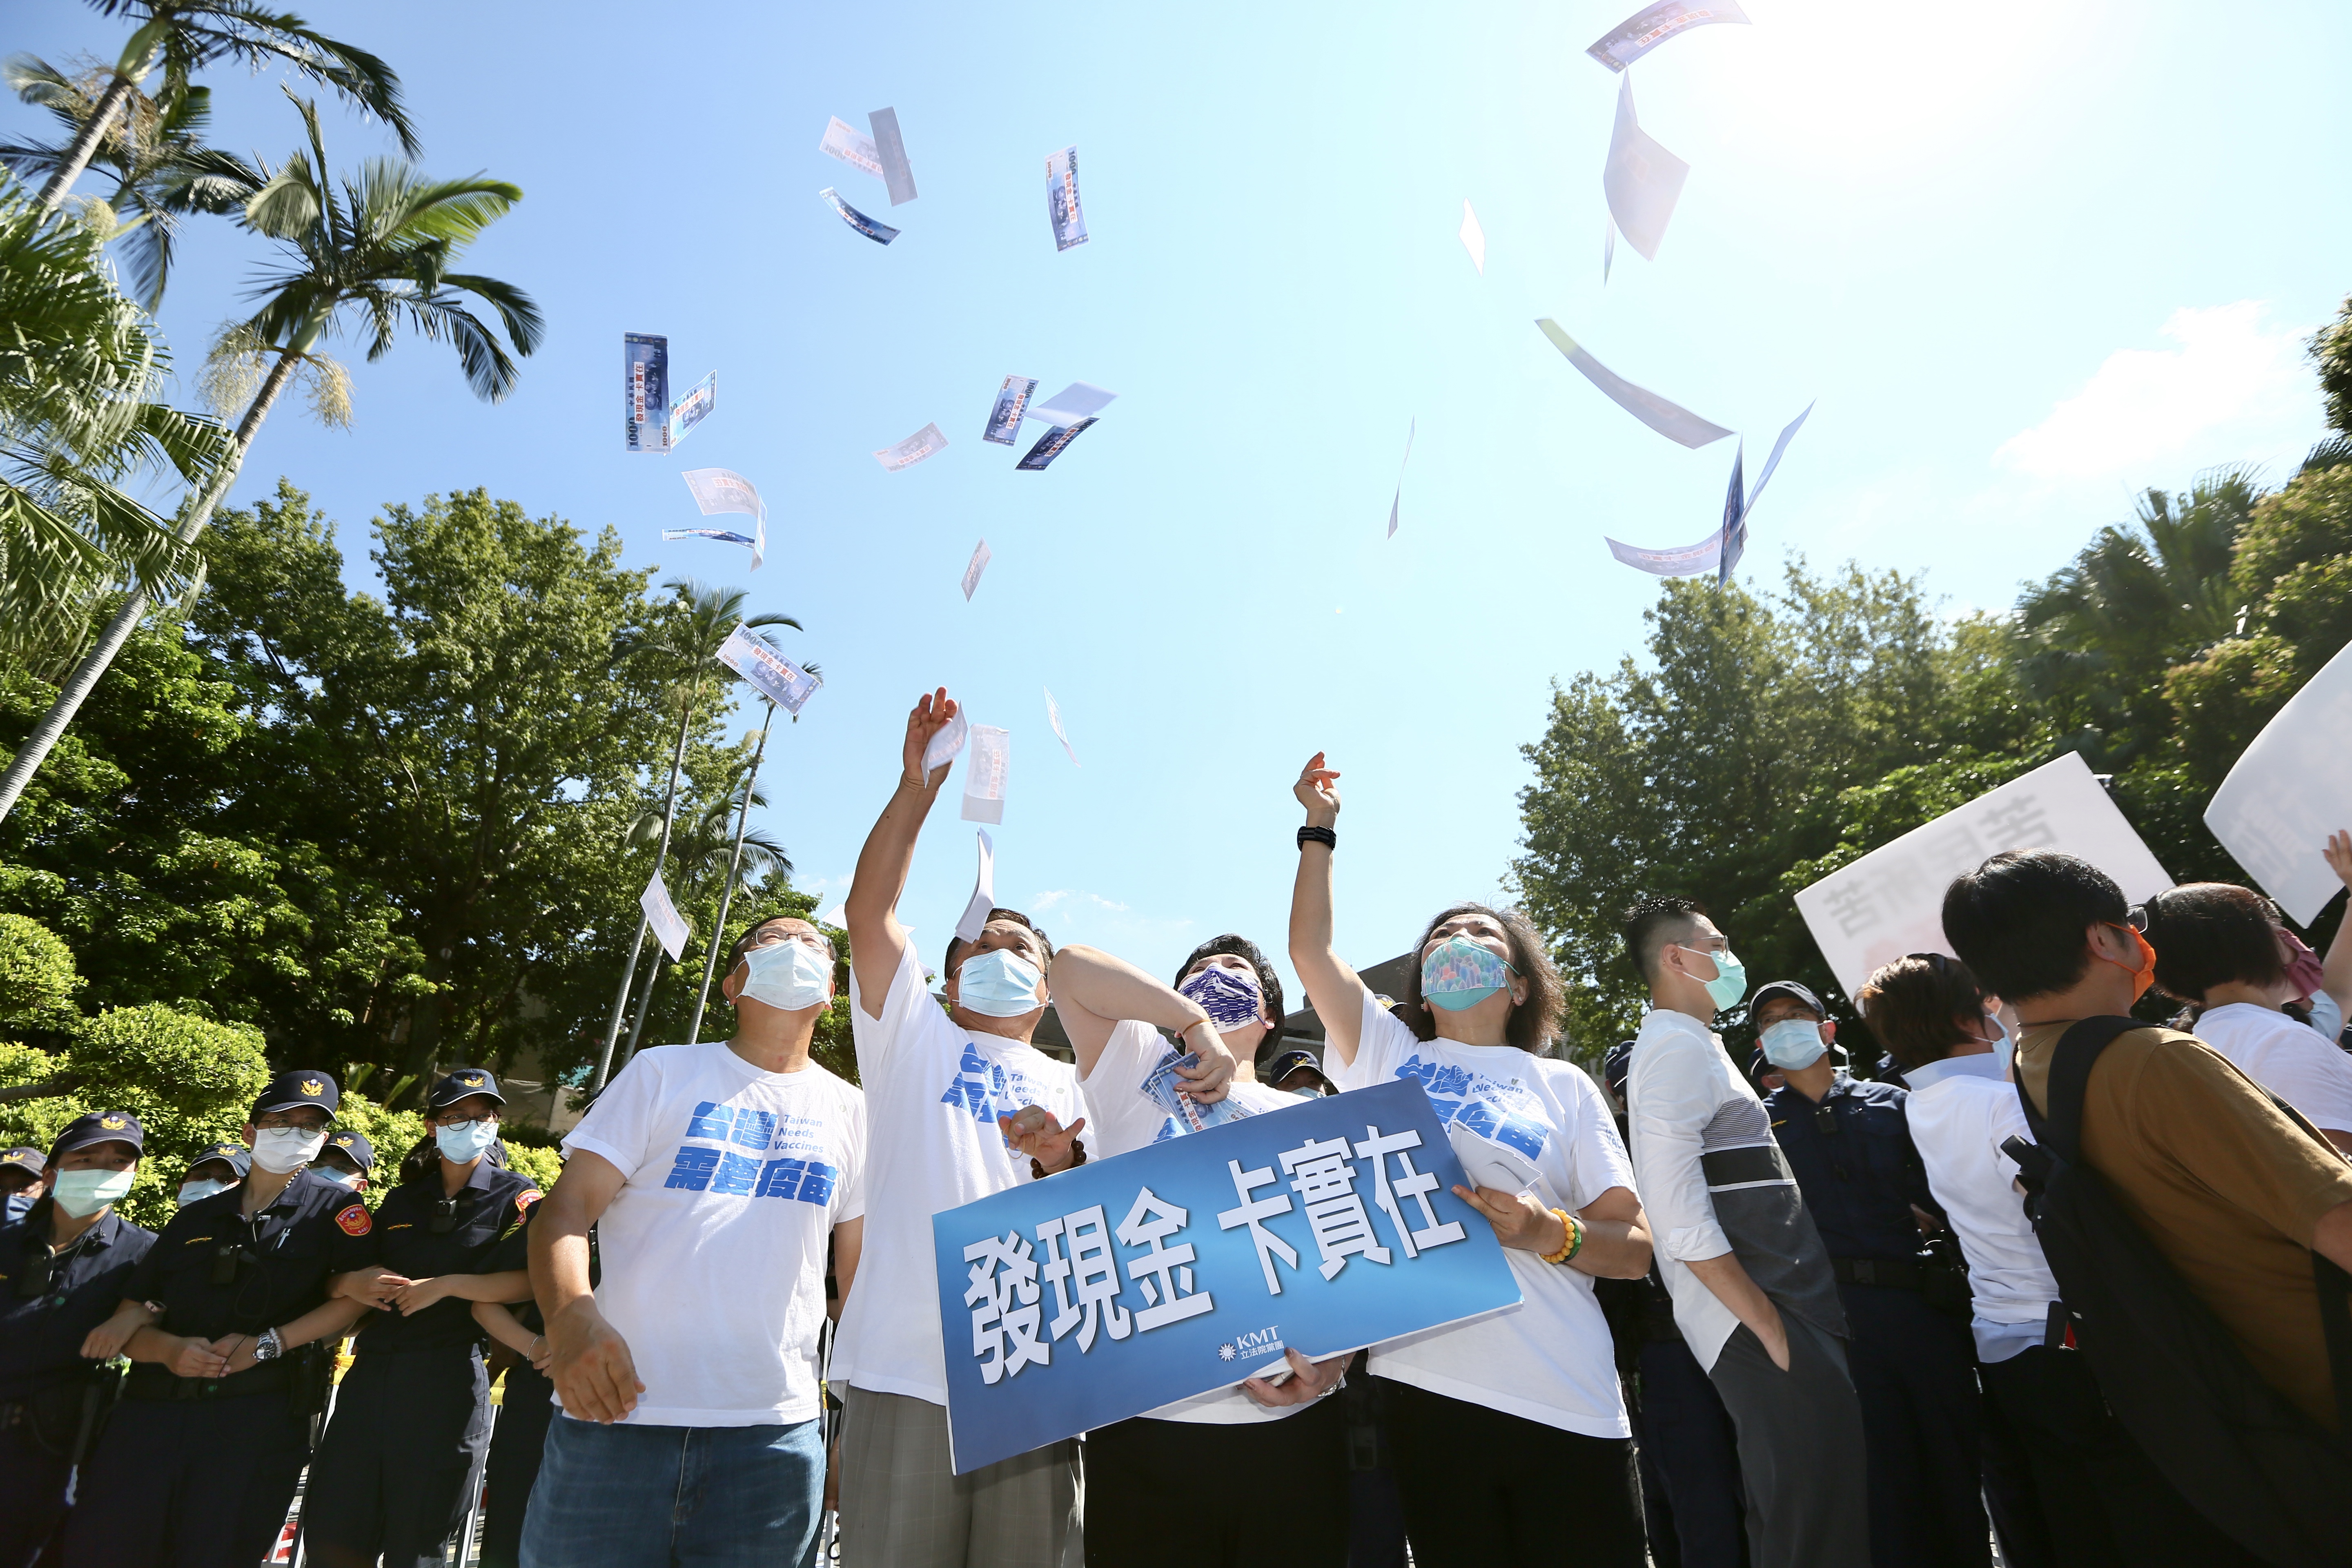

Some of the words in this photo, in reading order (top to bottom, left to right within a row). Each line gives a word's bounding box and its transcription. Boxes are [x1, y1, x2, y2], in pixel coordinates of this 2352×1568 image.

[635, 363, 644, 391] 卡實在
[1003, 378, 1011, 389] 1000
[1025, 381, 1036, 398] 1000
[635, 394, 644, 422] 發現金
[675, 401, 690, 417] 發現金
[690, 392, 704, 405] 卡實在
[1014, 394, 1025, 410] 發現金
[1007, 412, 1017, 428] 卡實在
[628, 416, 639, 447] 1000
[738, 628, 763, 648] 1000
[722, 653, 739, 667] 1000
[753, 647, 774, 666] 發現金
[775, 663, 795, 681] 卡實在
[1011, 1074, 1047, 1090] Taiwan
[1180, 1091, 1191, 1108] 卡實
[685, 1101, 779, 1151] 台灣
[784, 1114, 822, 1127] Taiwan
[778, 1127, 814, 1138] Needs
[774, 1140, 824, 1153] Vaccines
[664, 1146, 838, 1207] 需要疫苗
[963, 1187, 1213, 1385] 發現金
[1217, 1124, 1466, 1296] 卡實在
[1236, 1325, 1278, 1350] KMT
[1240, 1340, 1284, 1360] 立法院黨團
